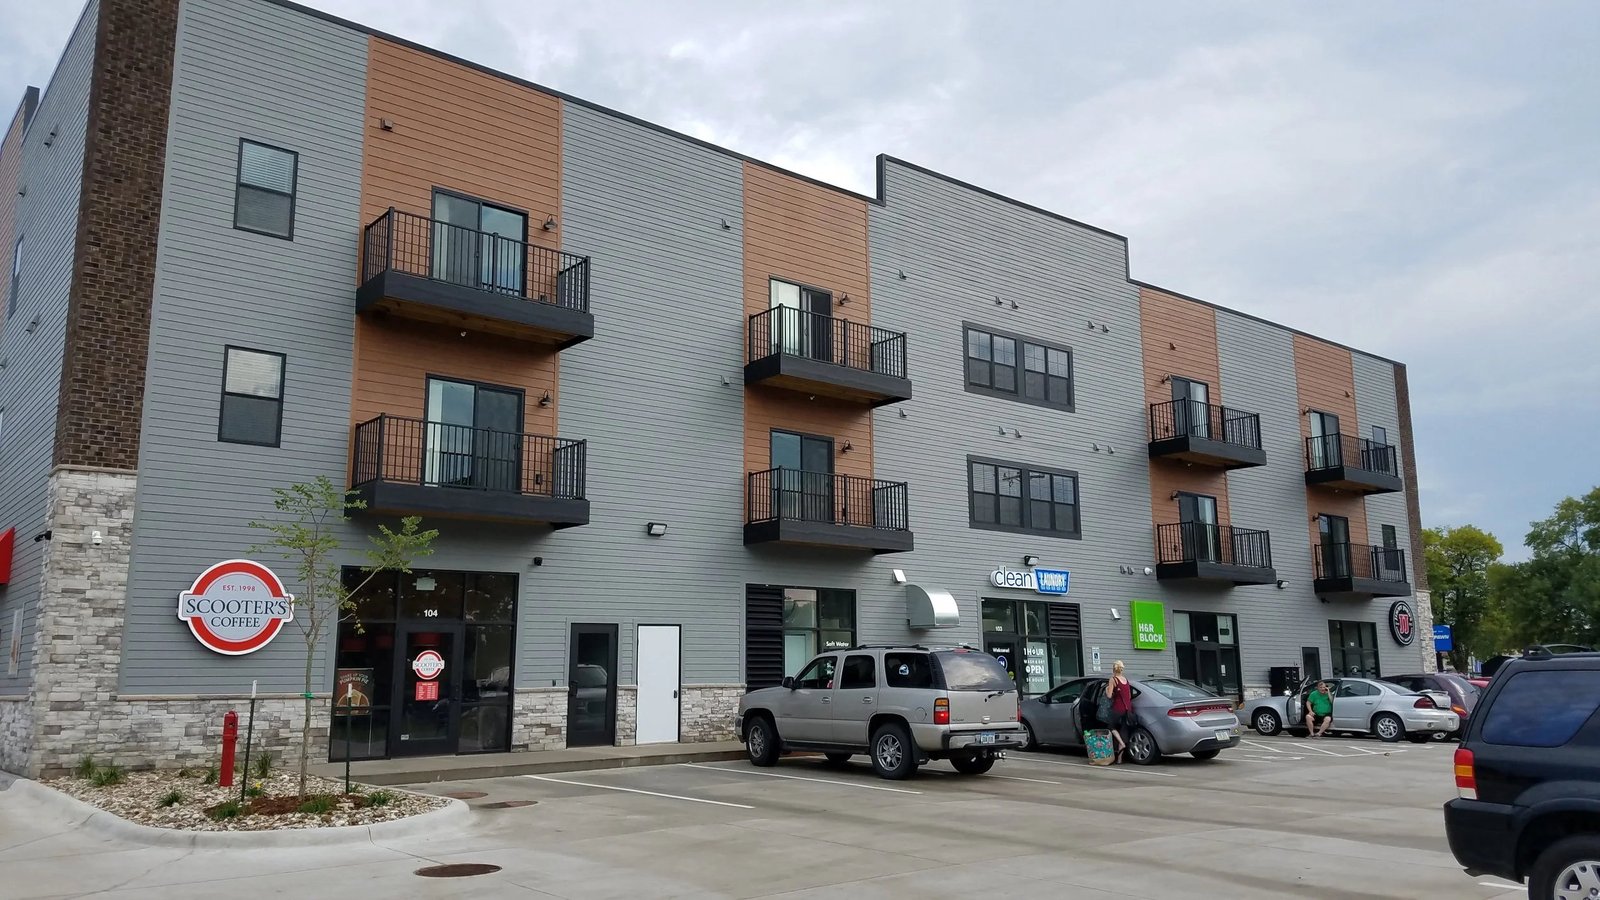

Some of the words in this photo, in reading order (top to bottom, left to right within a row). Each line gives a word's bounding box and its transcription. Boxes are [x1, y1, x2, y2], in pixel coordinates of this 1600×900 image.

[994, 566, 1033, 587] clean
[222, 584, 237, 592] EST.
[185, 598, 287, 615] SCOOTER'S
[423, 609, 438, 617] 104
[210, 616, 261, 628] COFFEE
[1138, 623, 1154, 632] H&R
[1139, 633, 1163, 643] BLOCK
[1025, 665, 1045, 674] OPEN
